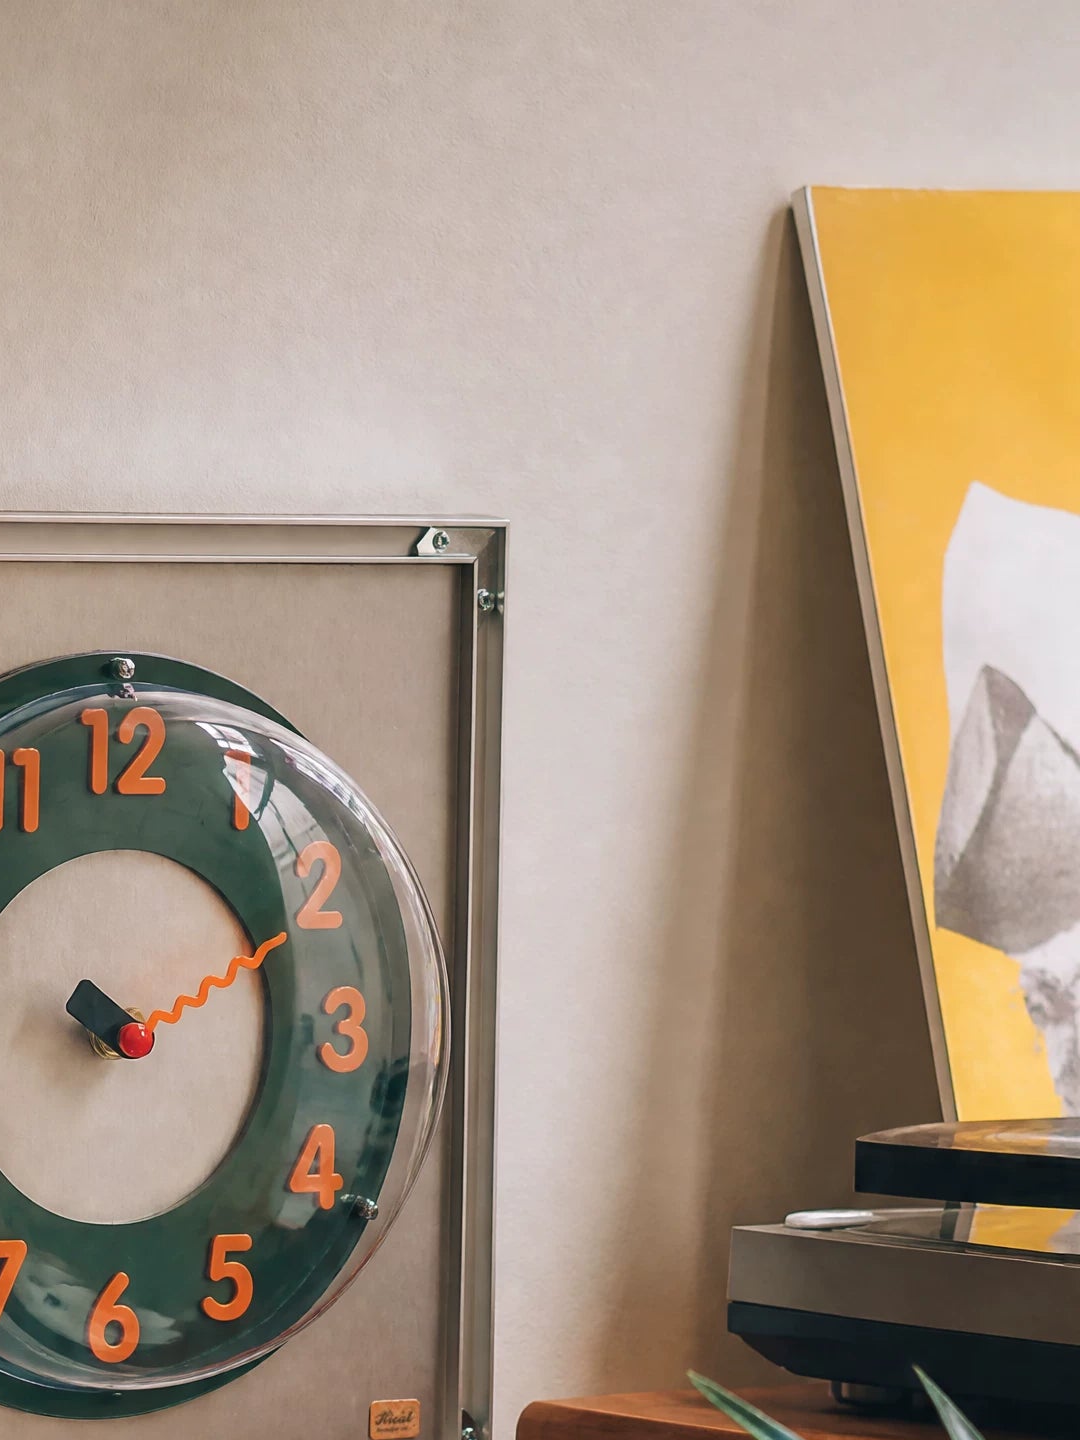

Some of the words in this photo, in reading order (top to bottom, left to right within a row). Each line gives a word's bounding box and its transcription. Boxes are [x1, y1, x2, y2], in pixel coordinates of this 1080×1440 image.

[83, 708, 166, 794] 12
[225, 749, 251, 831] 1
[296, 840, 343, 929] 2
[320, 987, 369, 1073] 3
[290, 1125, 344, 1210] 4
[89, 1273, 140, 1363] 6
[203, 1234, 254, 1321] 5
